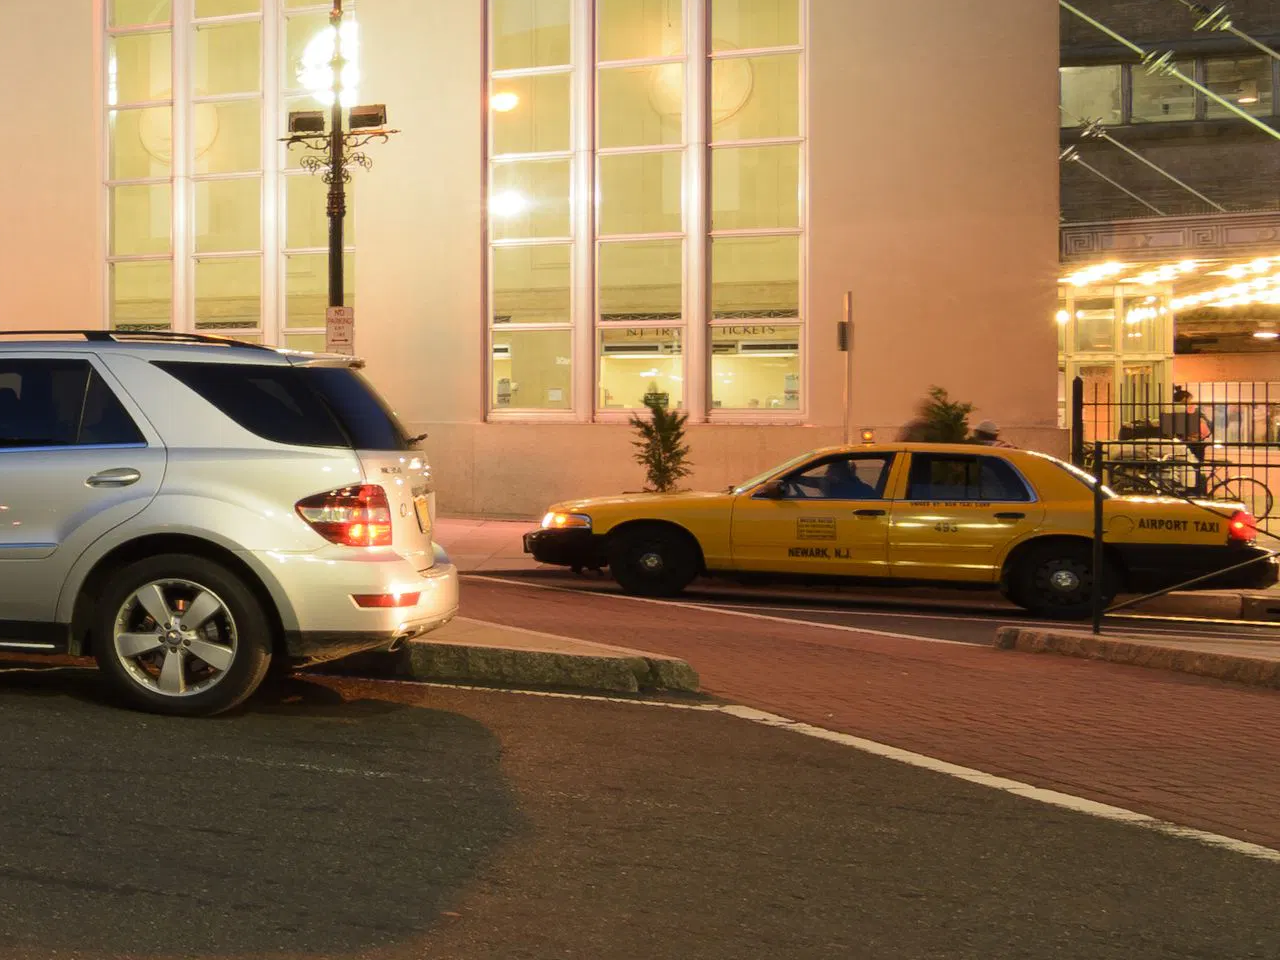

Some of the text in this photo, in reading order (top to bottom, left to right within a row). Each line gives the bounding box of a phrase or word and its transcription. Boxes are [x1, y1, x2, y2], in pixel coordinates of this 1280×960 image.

[721, 326, 776, 336] TICKETS
[1138, 518, 1220, 533] AIRPORT TAXI
[788, 547, 831, 560] NEWARK,
